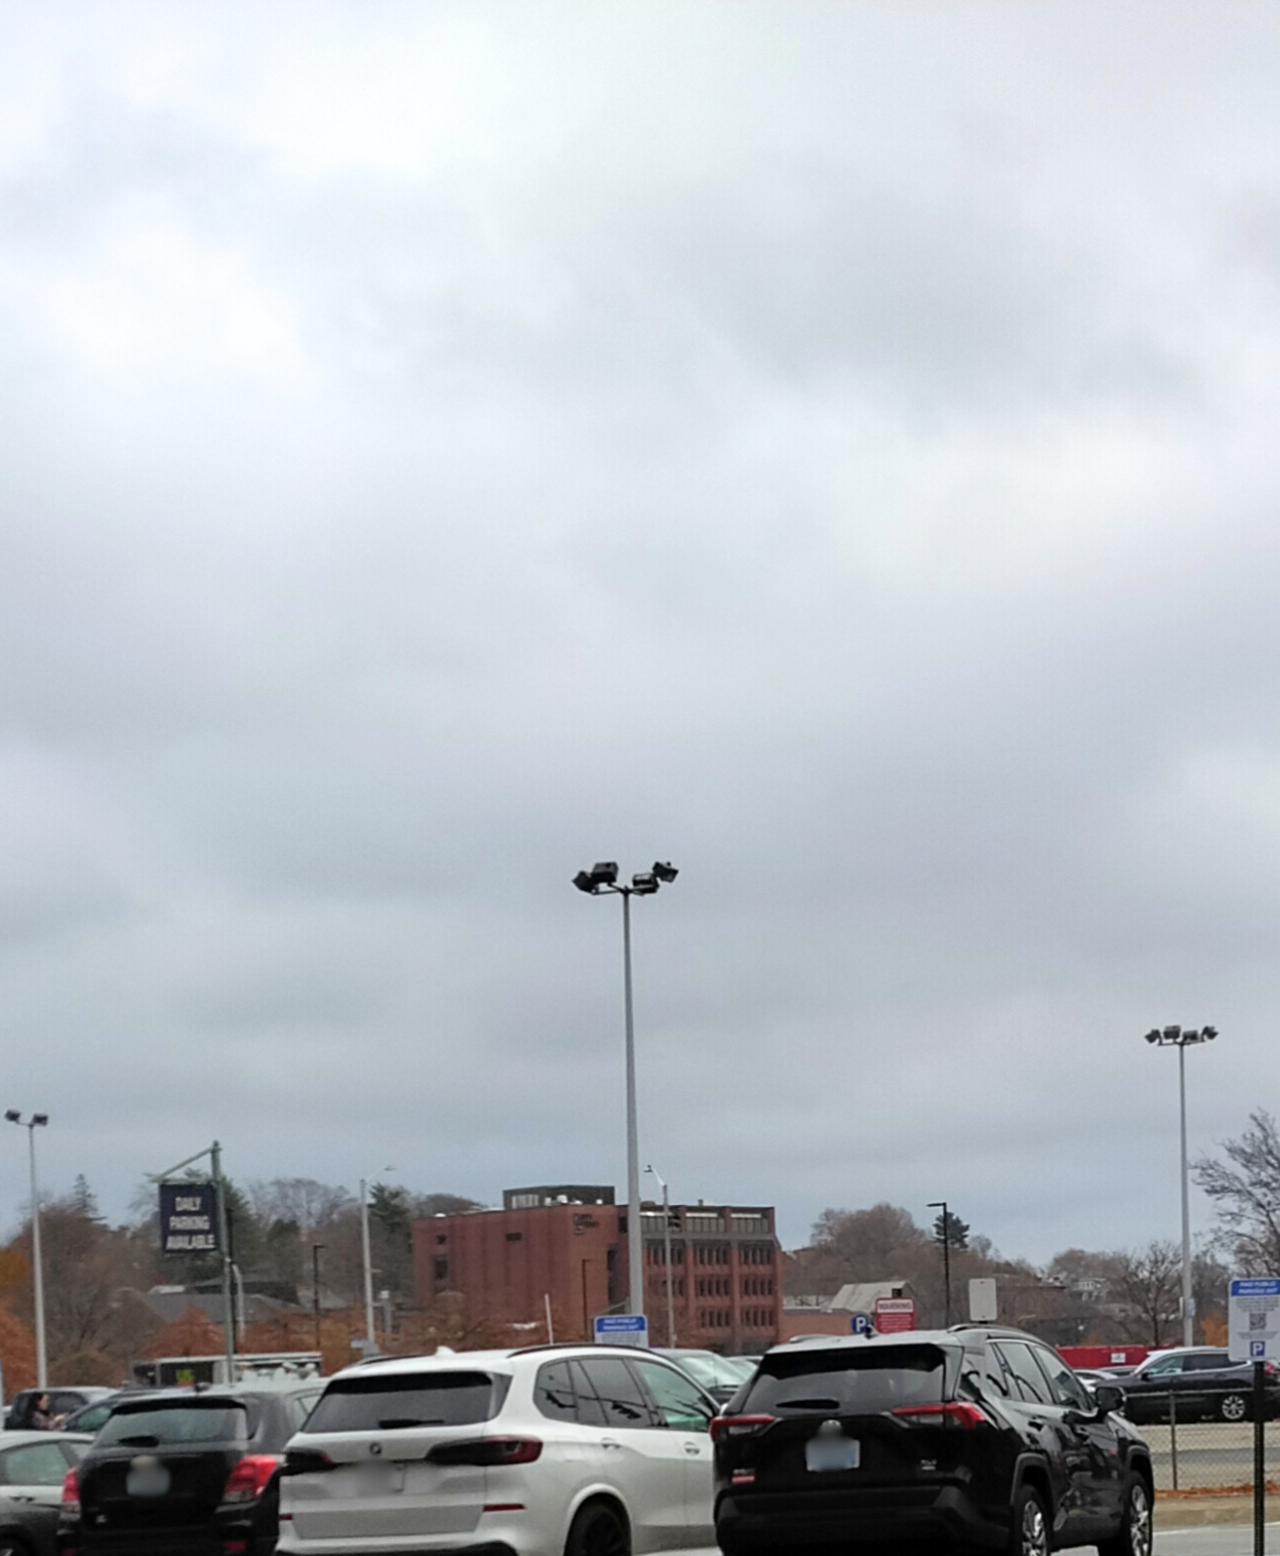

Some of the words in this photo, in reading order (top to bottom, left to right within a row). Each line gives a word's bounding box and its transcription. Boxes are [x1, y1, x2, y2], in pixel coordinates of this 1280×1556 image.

[175, 1196, 202, 1212] DAILY
[169, 1215, 210, 1231] PARKING
[165, 1234, 216, 1250] AVAILABLE
[855, 1316, 867, 1333] P
[1252, 1342, 1264, 1357] P
